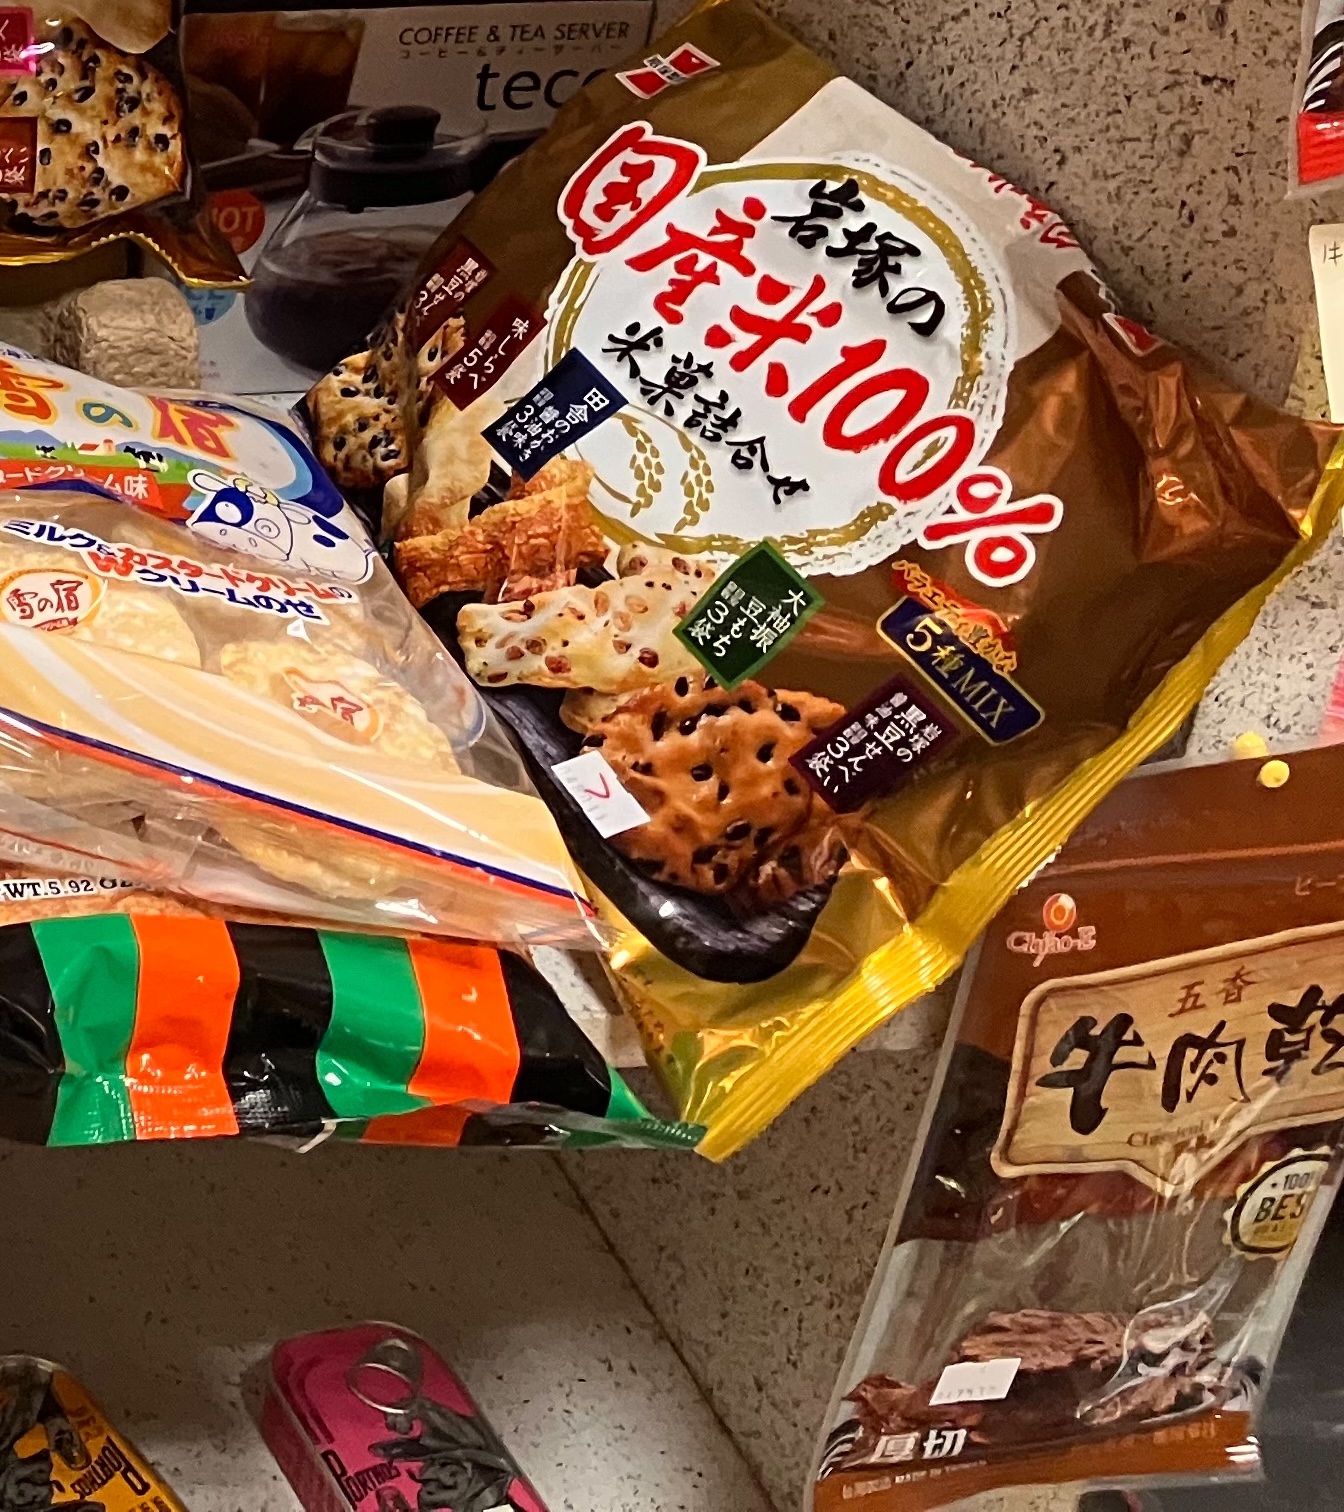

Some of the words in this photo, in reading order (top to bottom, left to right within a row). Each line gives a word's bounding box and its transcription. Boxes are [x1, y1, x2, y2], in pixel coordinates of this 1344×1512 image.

[398, 24, 479, 46] COFFEE
[486, 25, 500, 44] &
[510, 24, 545, 42] TEA
[554, 21, 630, 41] SERVER
[475, 62, 608, 112] tec
[770, 178, 946, 337] 岩塚の
[563, 125, 1057, 579] 国産米100%
[518, 386, 611, 463] 田舎のおかき
[602, 320, 811, 506] 米菓詰合せ
[6, 579, 85, 621] 雪の宿
[905, 615, 1017, 731] 5種MIX
[1168, 965, 1259, 1018] 五香
[1252, 1194, 1310, 1224] BES
